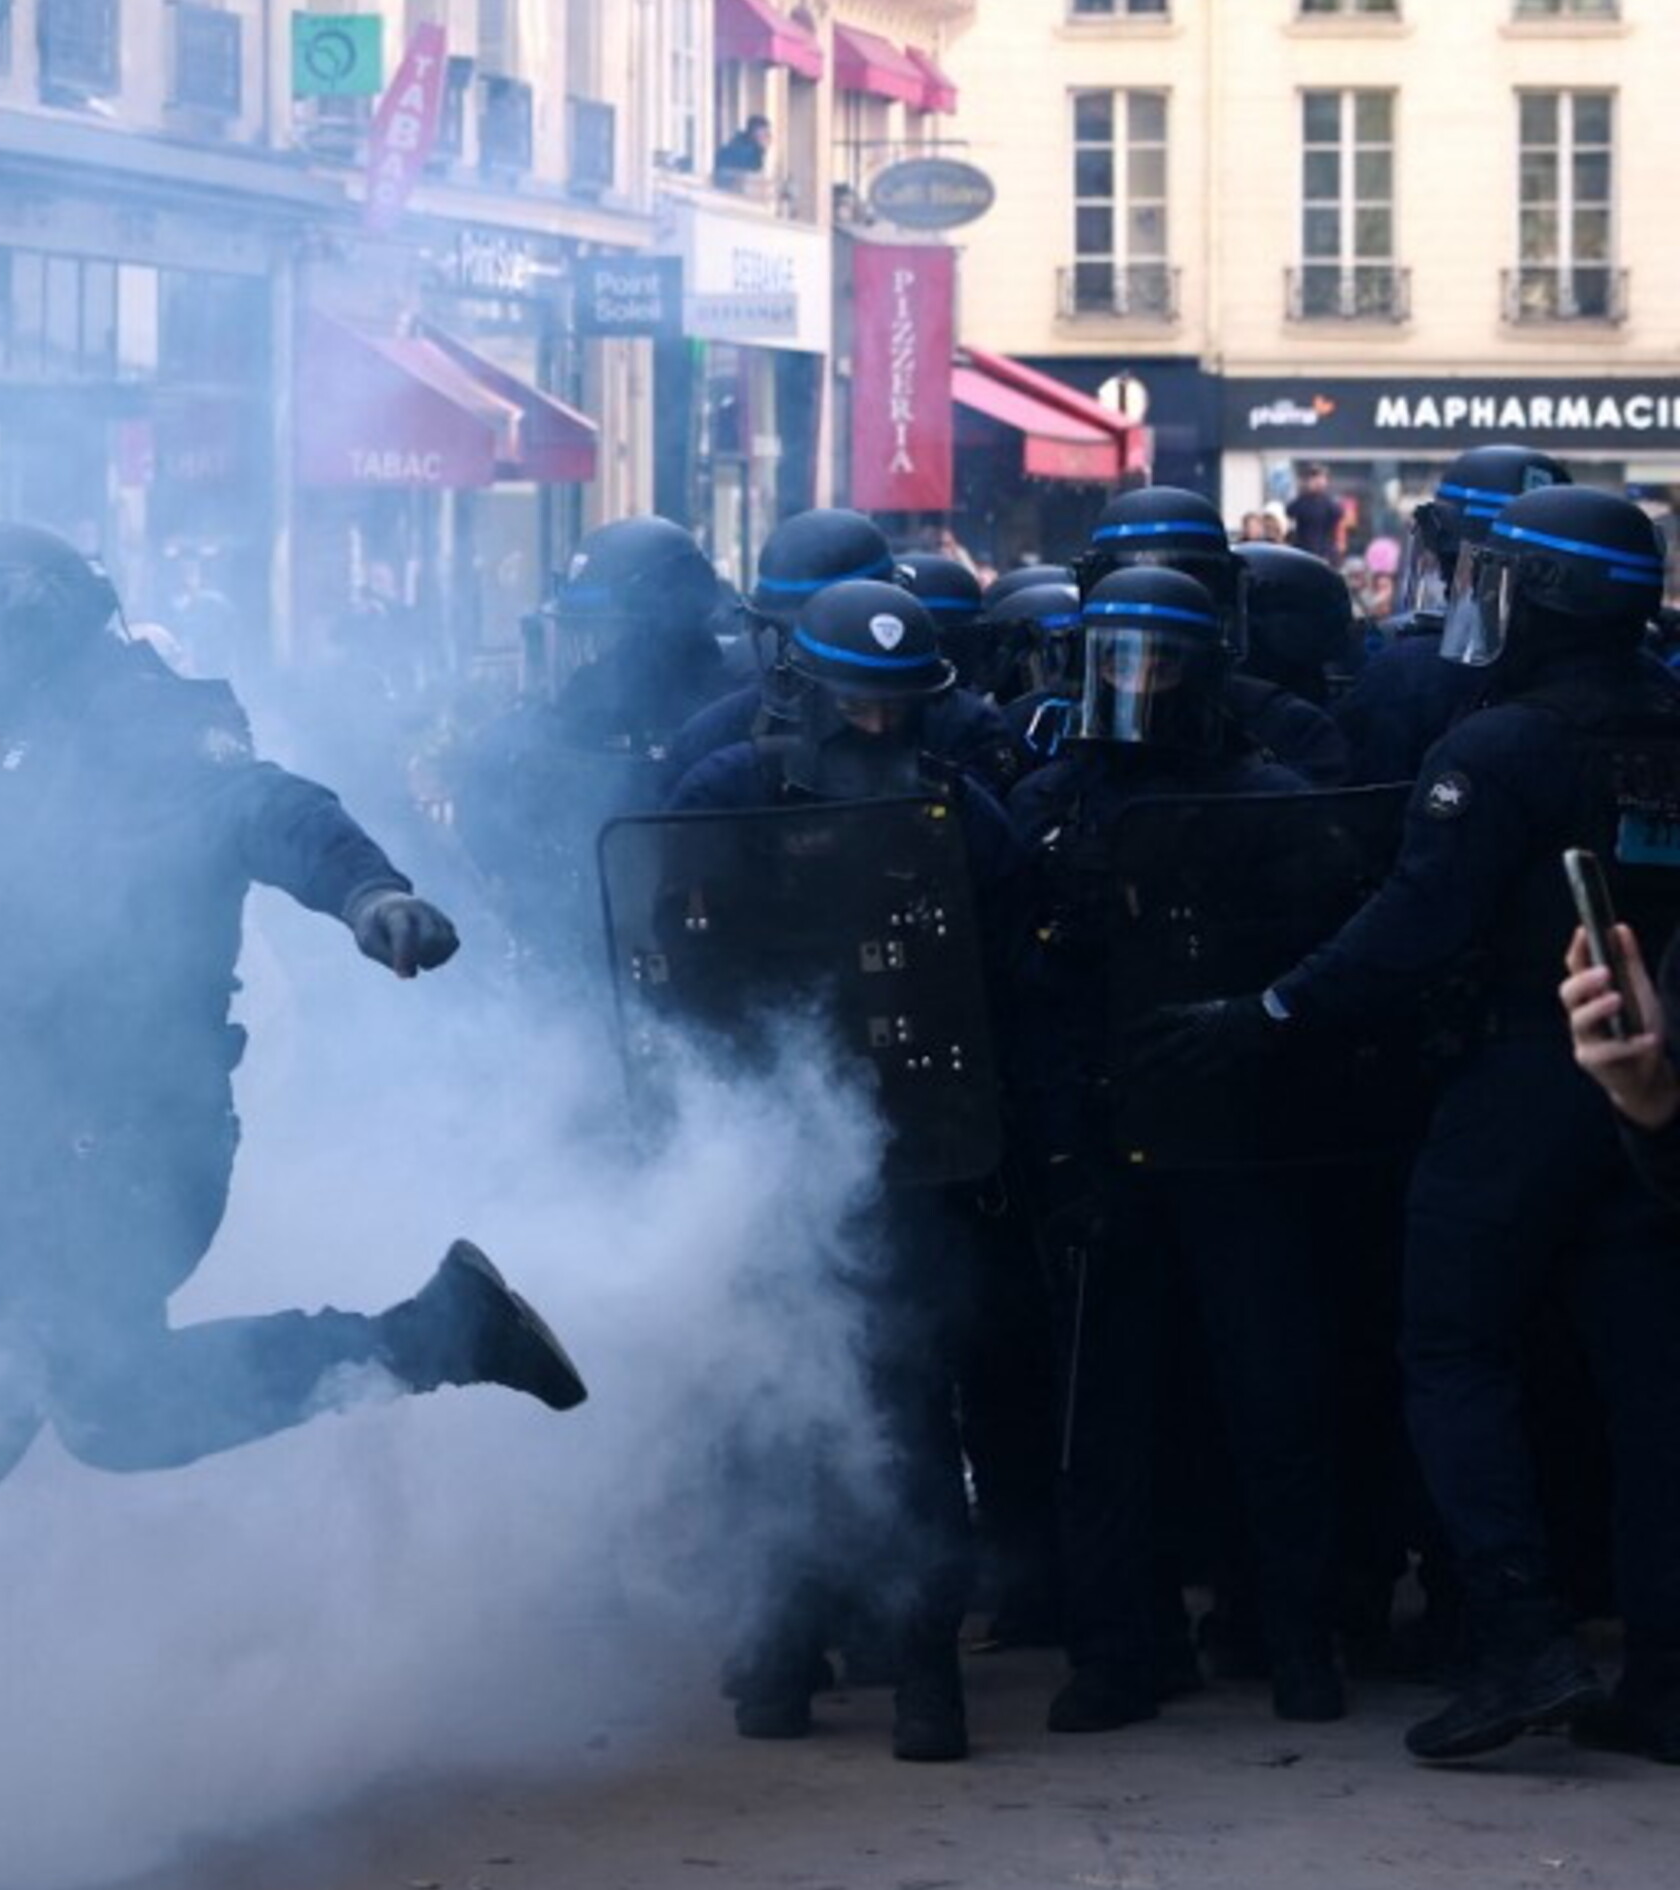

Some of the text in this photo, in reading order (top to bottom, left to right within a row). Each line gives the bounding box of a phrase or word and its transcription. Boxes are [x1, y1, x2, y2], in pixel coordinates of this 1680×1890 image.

[376, 53, 435, 205] TABAC
[594, 270, 659, 296] Point
[887, 270, 917, 474] PIZZERIA
[346, 449, 443, 480] TABAC
